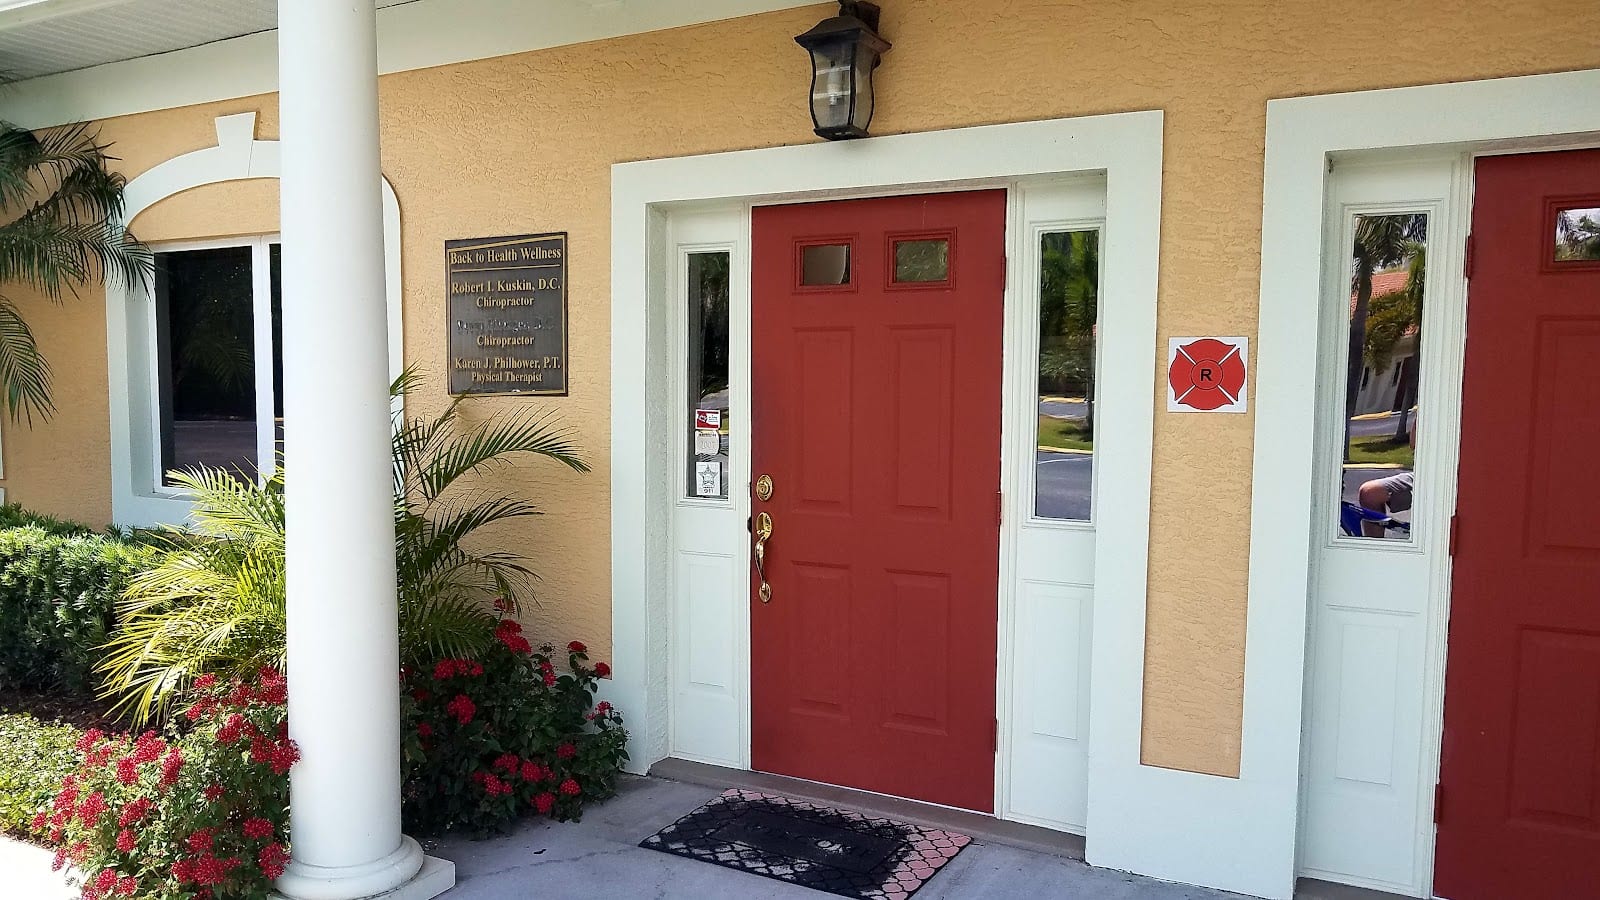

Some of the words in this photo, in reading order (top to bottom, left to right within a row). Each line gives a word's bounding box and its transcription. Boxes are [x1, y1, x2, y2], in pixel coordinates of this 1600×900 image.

[450, 252, 473, 264] Back
[475, 251, 485, 263] to
[487, 249, 517, 262] Health
[520, 246, 562, 260] Wellness
[452, 281, 484, 294] Robert
[487, 280, 494, 292] I.
[497, 279, 535, 292] Kuskin,
[538, 277, 561, 290] D.C.
[476, 297, 535, 309] Chiropractor
[477, 335, 535, 348] Chiropractor
[455, 358, 481, 369] Karen
[483, 358, 492, 369] J.
[494, 357, 541, 371] Philhower,
[543, 356, 561, 369] P.T.
[471, 372, 503, 384] Physical
[505, 371, 543, 384] Therapist
[1200, 368, 1213, 382] R
